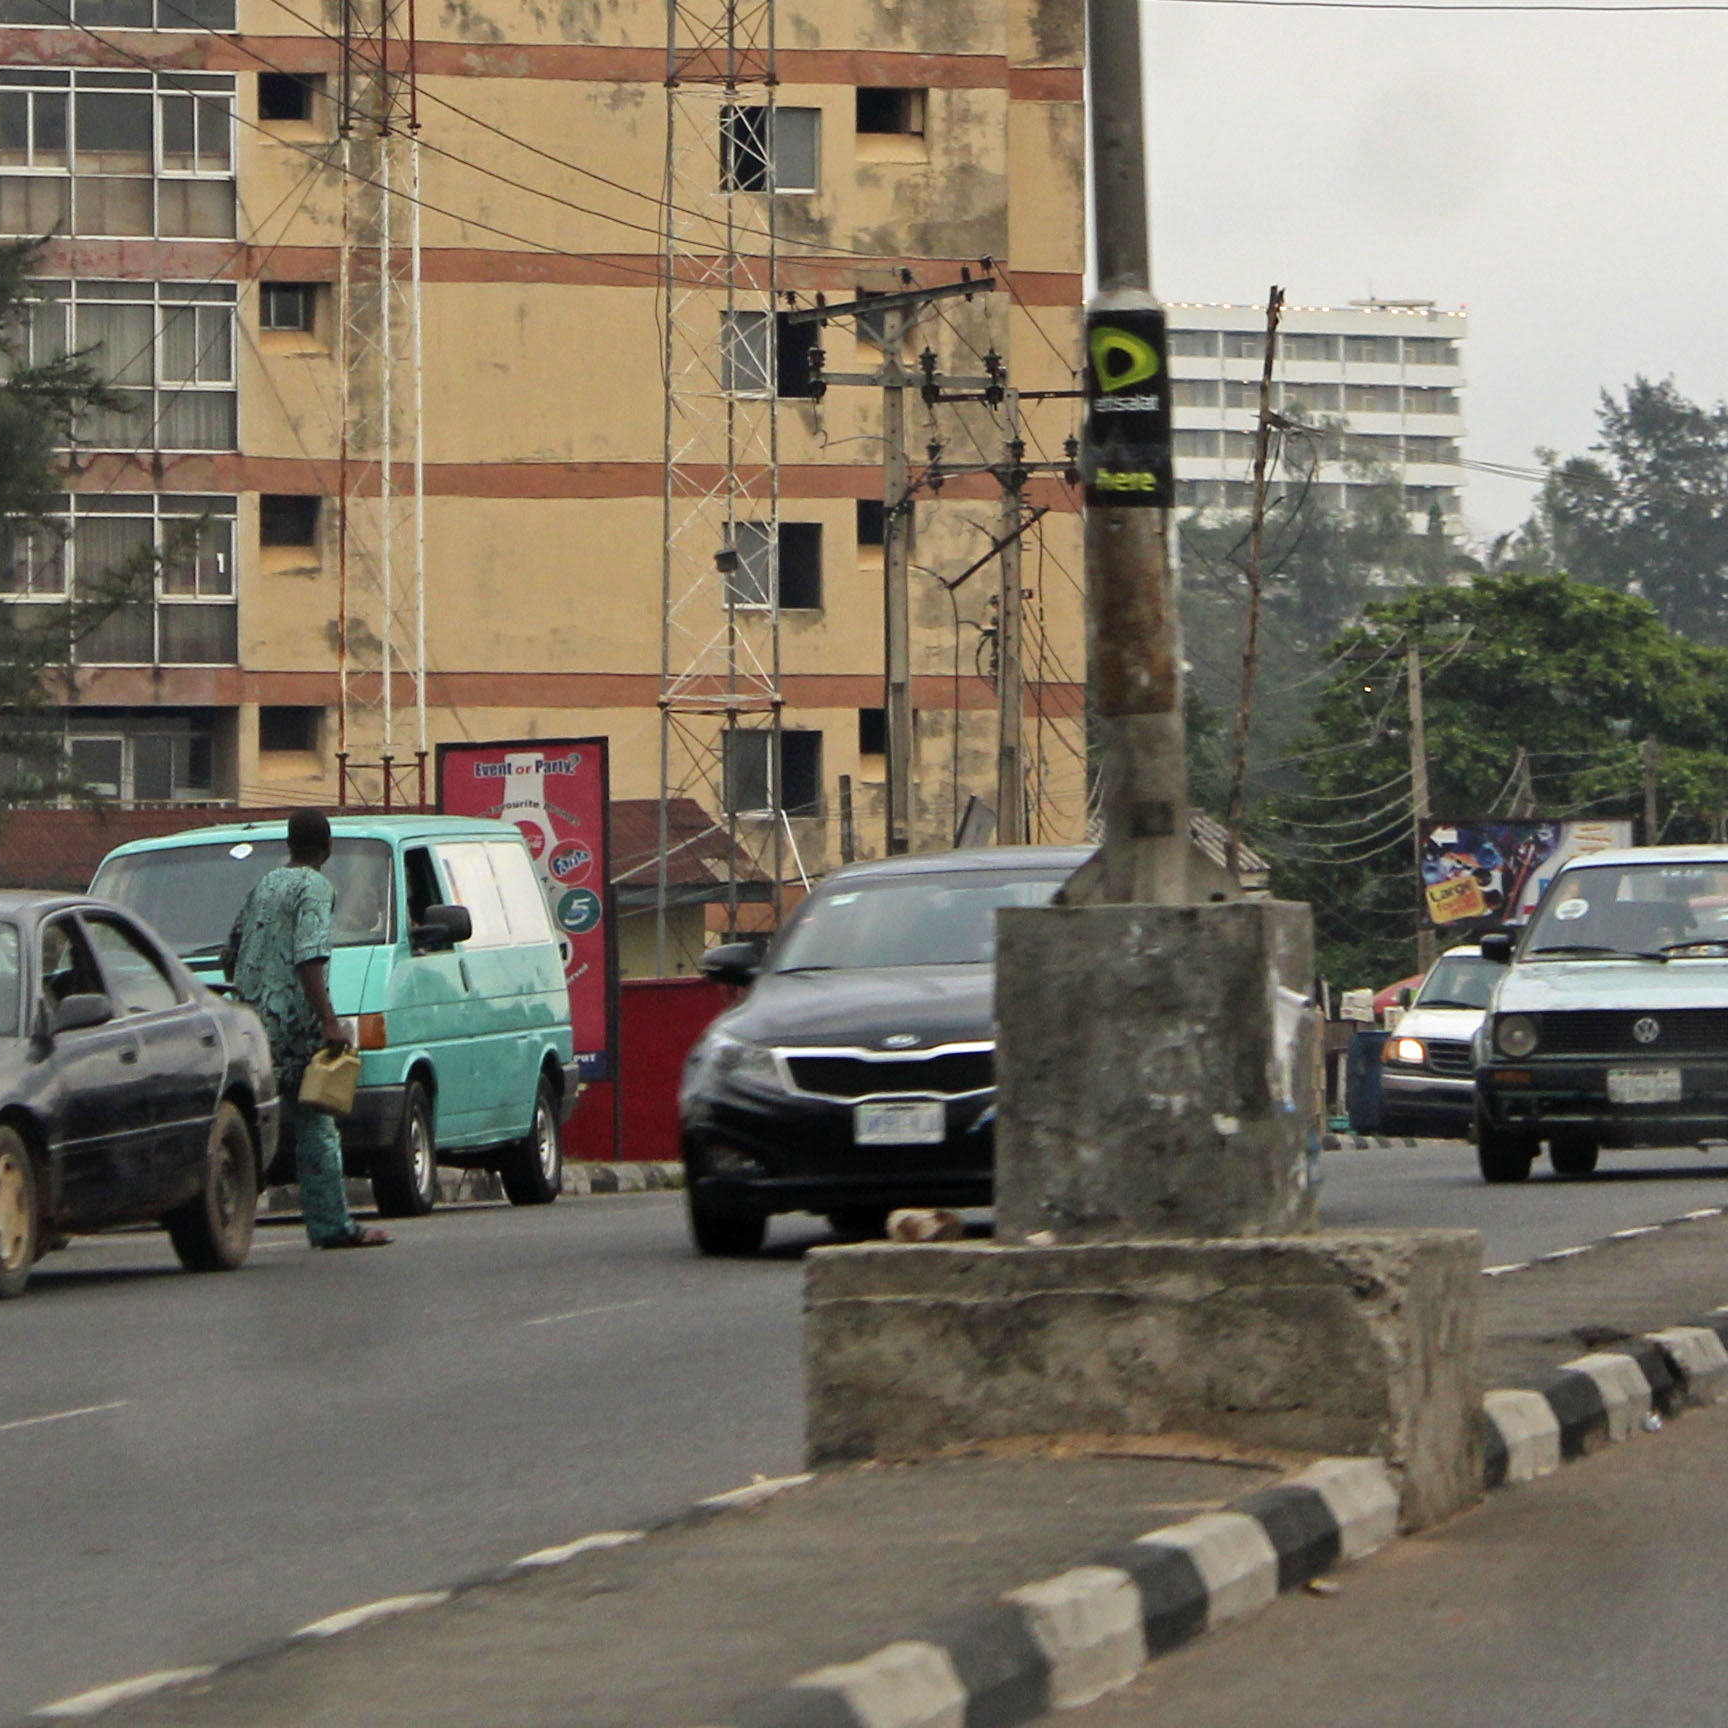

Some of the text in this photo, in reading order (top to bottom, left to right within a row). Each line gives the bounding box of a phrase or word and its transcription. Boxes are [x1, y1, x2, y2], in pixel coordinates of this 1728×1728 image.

[475, 753, 582, 777] Event or Party?
